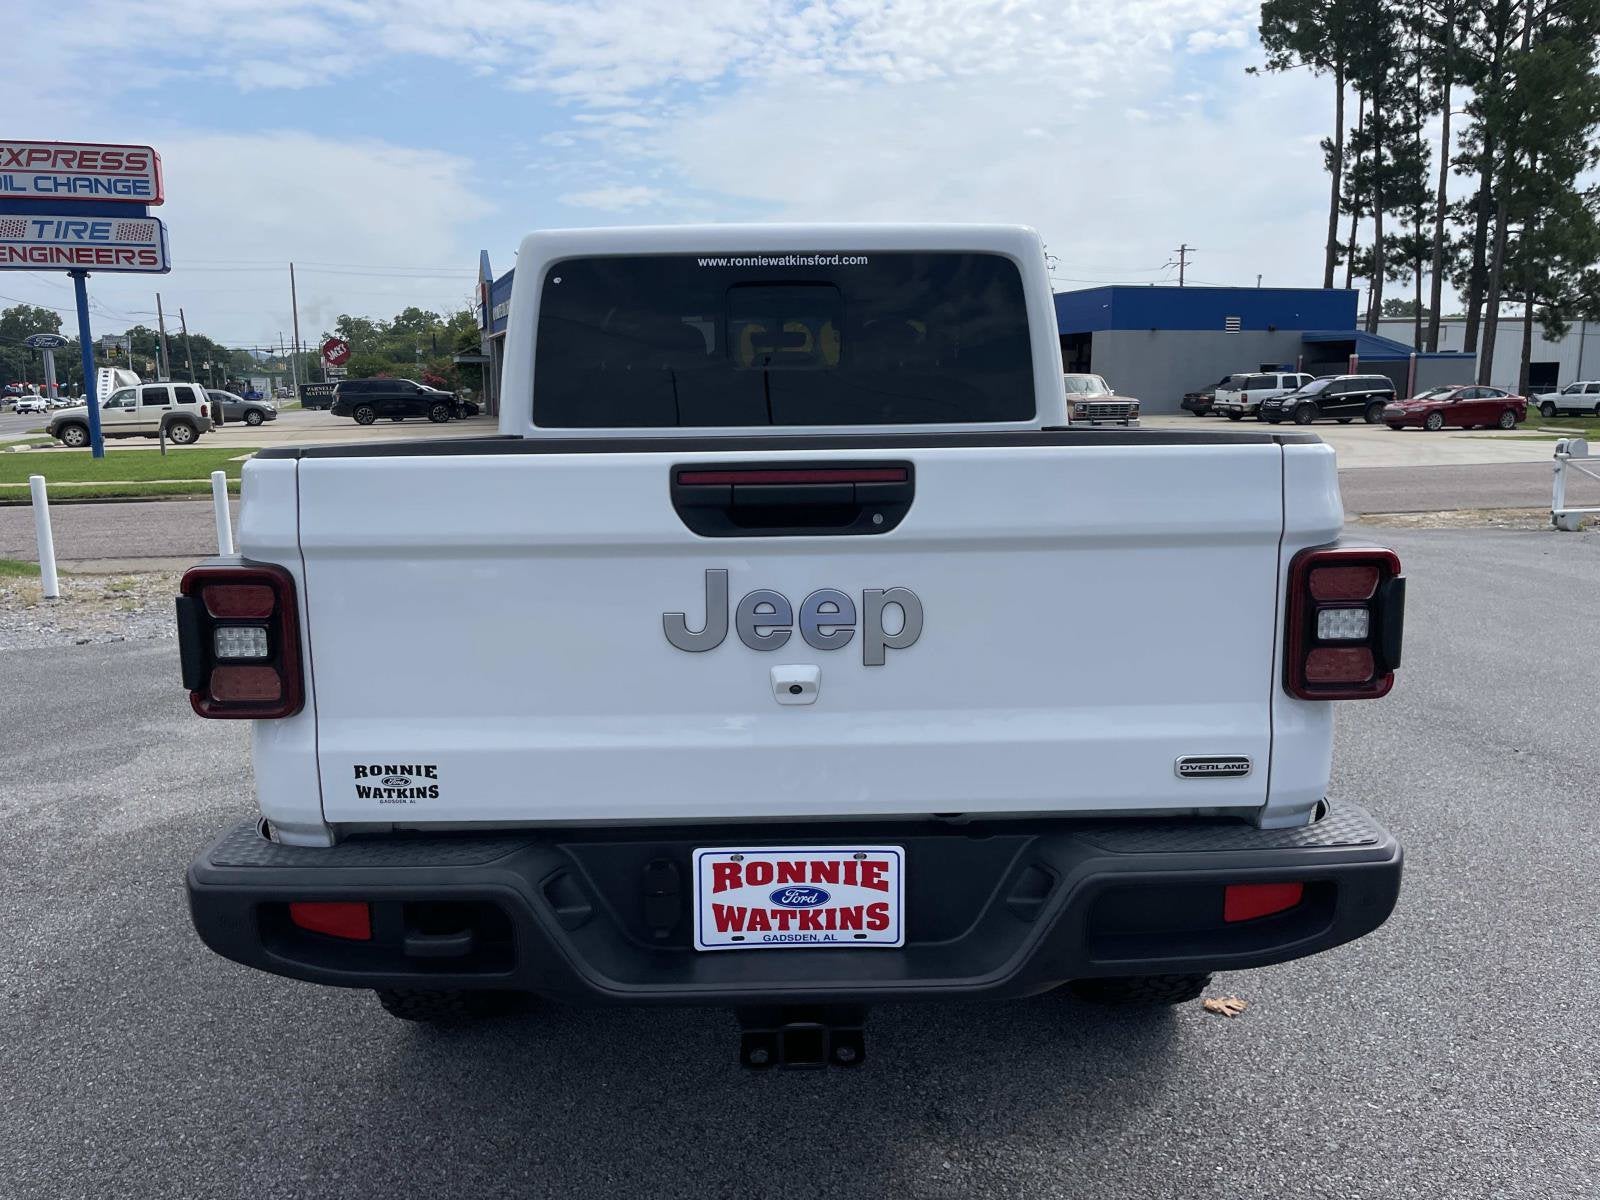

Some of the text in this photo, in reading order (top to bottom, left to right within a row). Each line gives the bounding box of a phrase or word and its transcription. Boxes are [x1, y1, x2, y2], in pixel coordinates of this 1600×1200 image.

[0, 148, 148, 171] XPRESS
[0, 175, 150, 195] IL CHANGE
[32, 220, 112, 240] TIRE
[698, 255, 868, 266] www.ronniewatkinsford.com
[663, 569, 923, 666] Jeep
[354, 765, 438, 779] RONNIE
[356, 784, 439, 799] WATKINS
[713, 860, 889, 894] RONNIE
[782, 887, 818, 904] Ford
[712, 902, 890, 932] WATKINS
[763, 934, 820, 943] GADSDEN,
